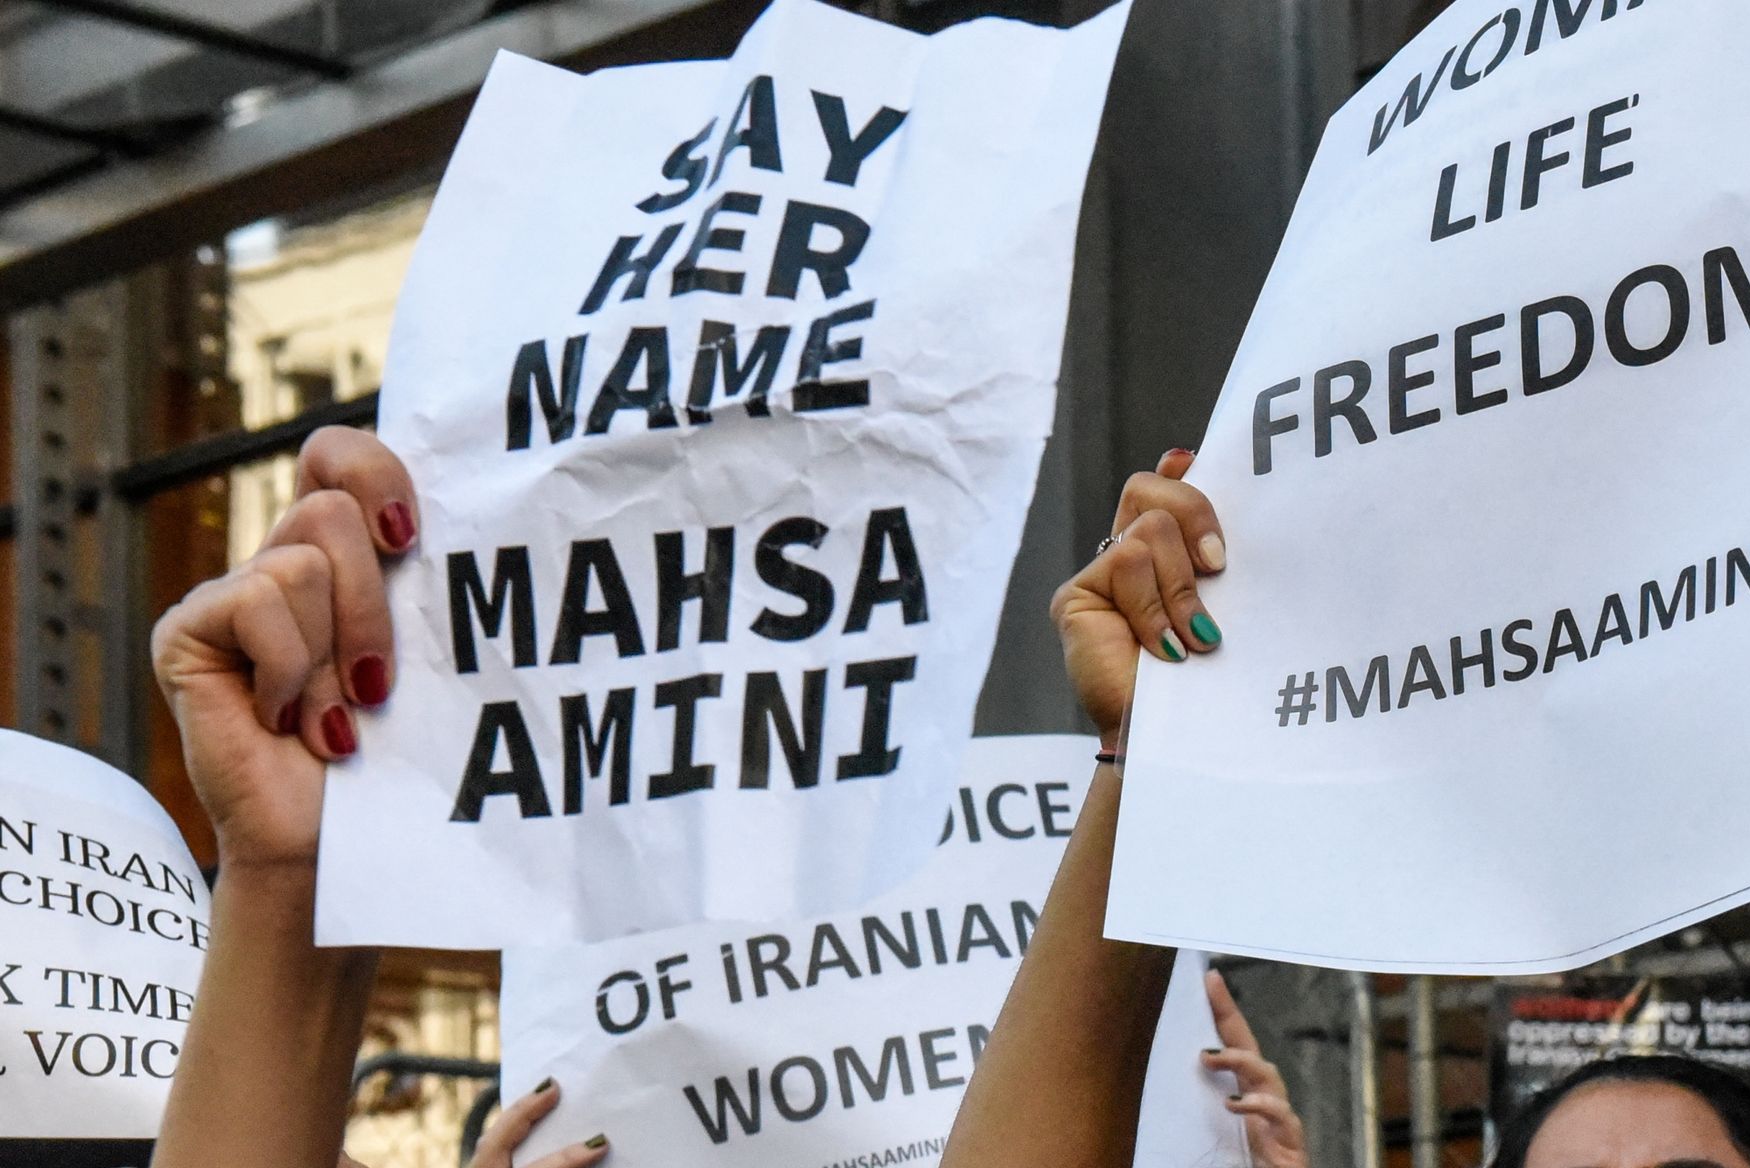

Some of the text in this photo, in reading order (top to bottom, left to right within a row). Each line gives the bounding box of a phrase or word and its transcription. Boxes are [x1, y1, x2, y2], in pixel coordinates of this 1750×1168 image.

[635, 74, 909, 215] SAY
[1367, 0, 1644, 157] WOM
[1430, 93, 1640, 243] LIFE
[578, 192, 872, 315] HER
[506, 299, 877, 452] NAME
[446, 506, 929, 675] MAHSA
[448, 655, 918, 823] AMINI
[57, 829, 197, 905] IRAN
[937, 782, 1076, 846] ICE
[23, 1030, 180, 1080] VOIC
[44, 967, 195, 1024] TIME
[595, 952, 693, 1036] OF
